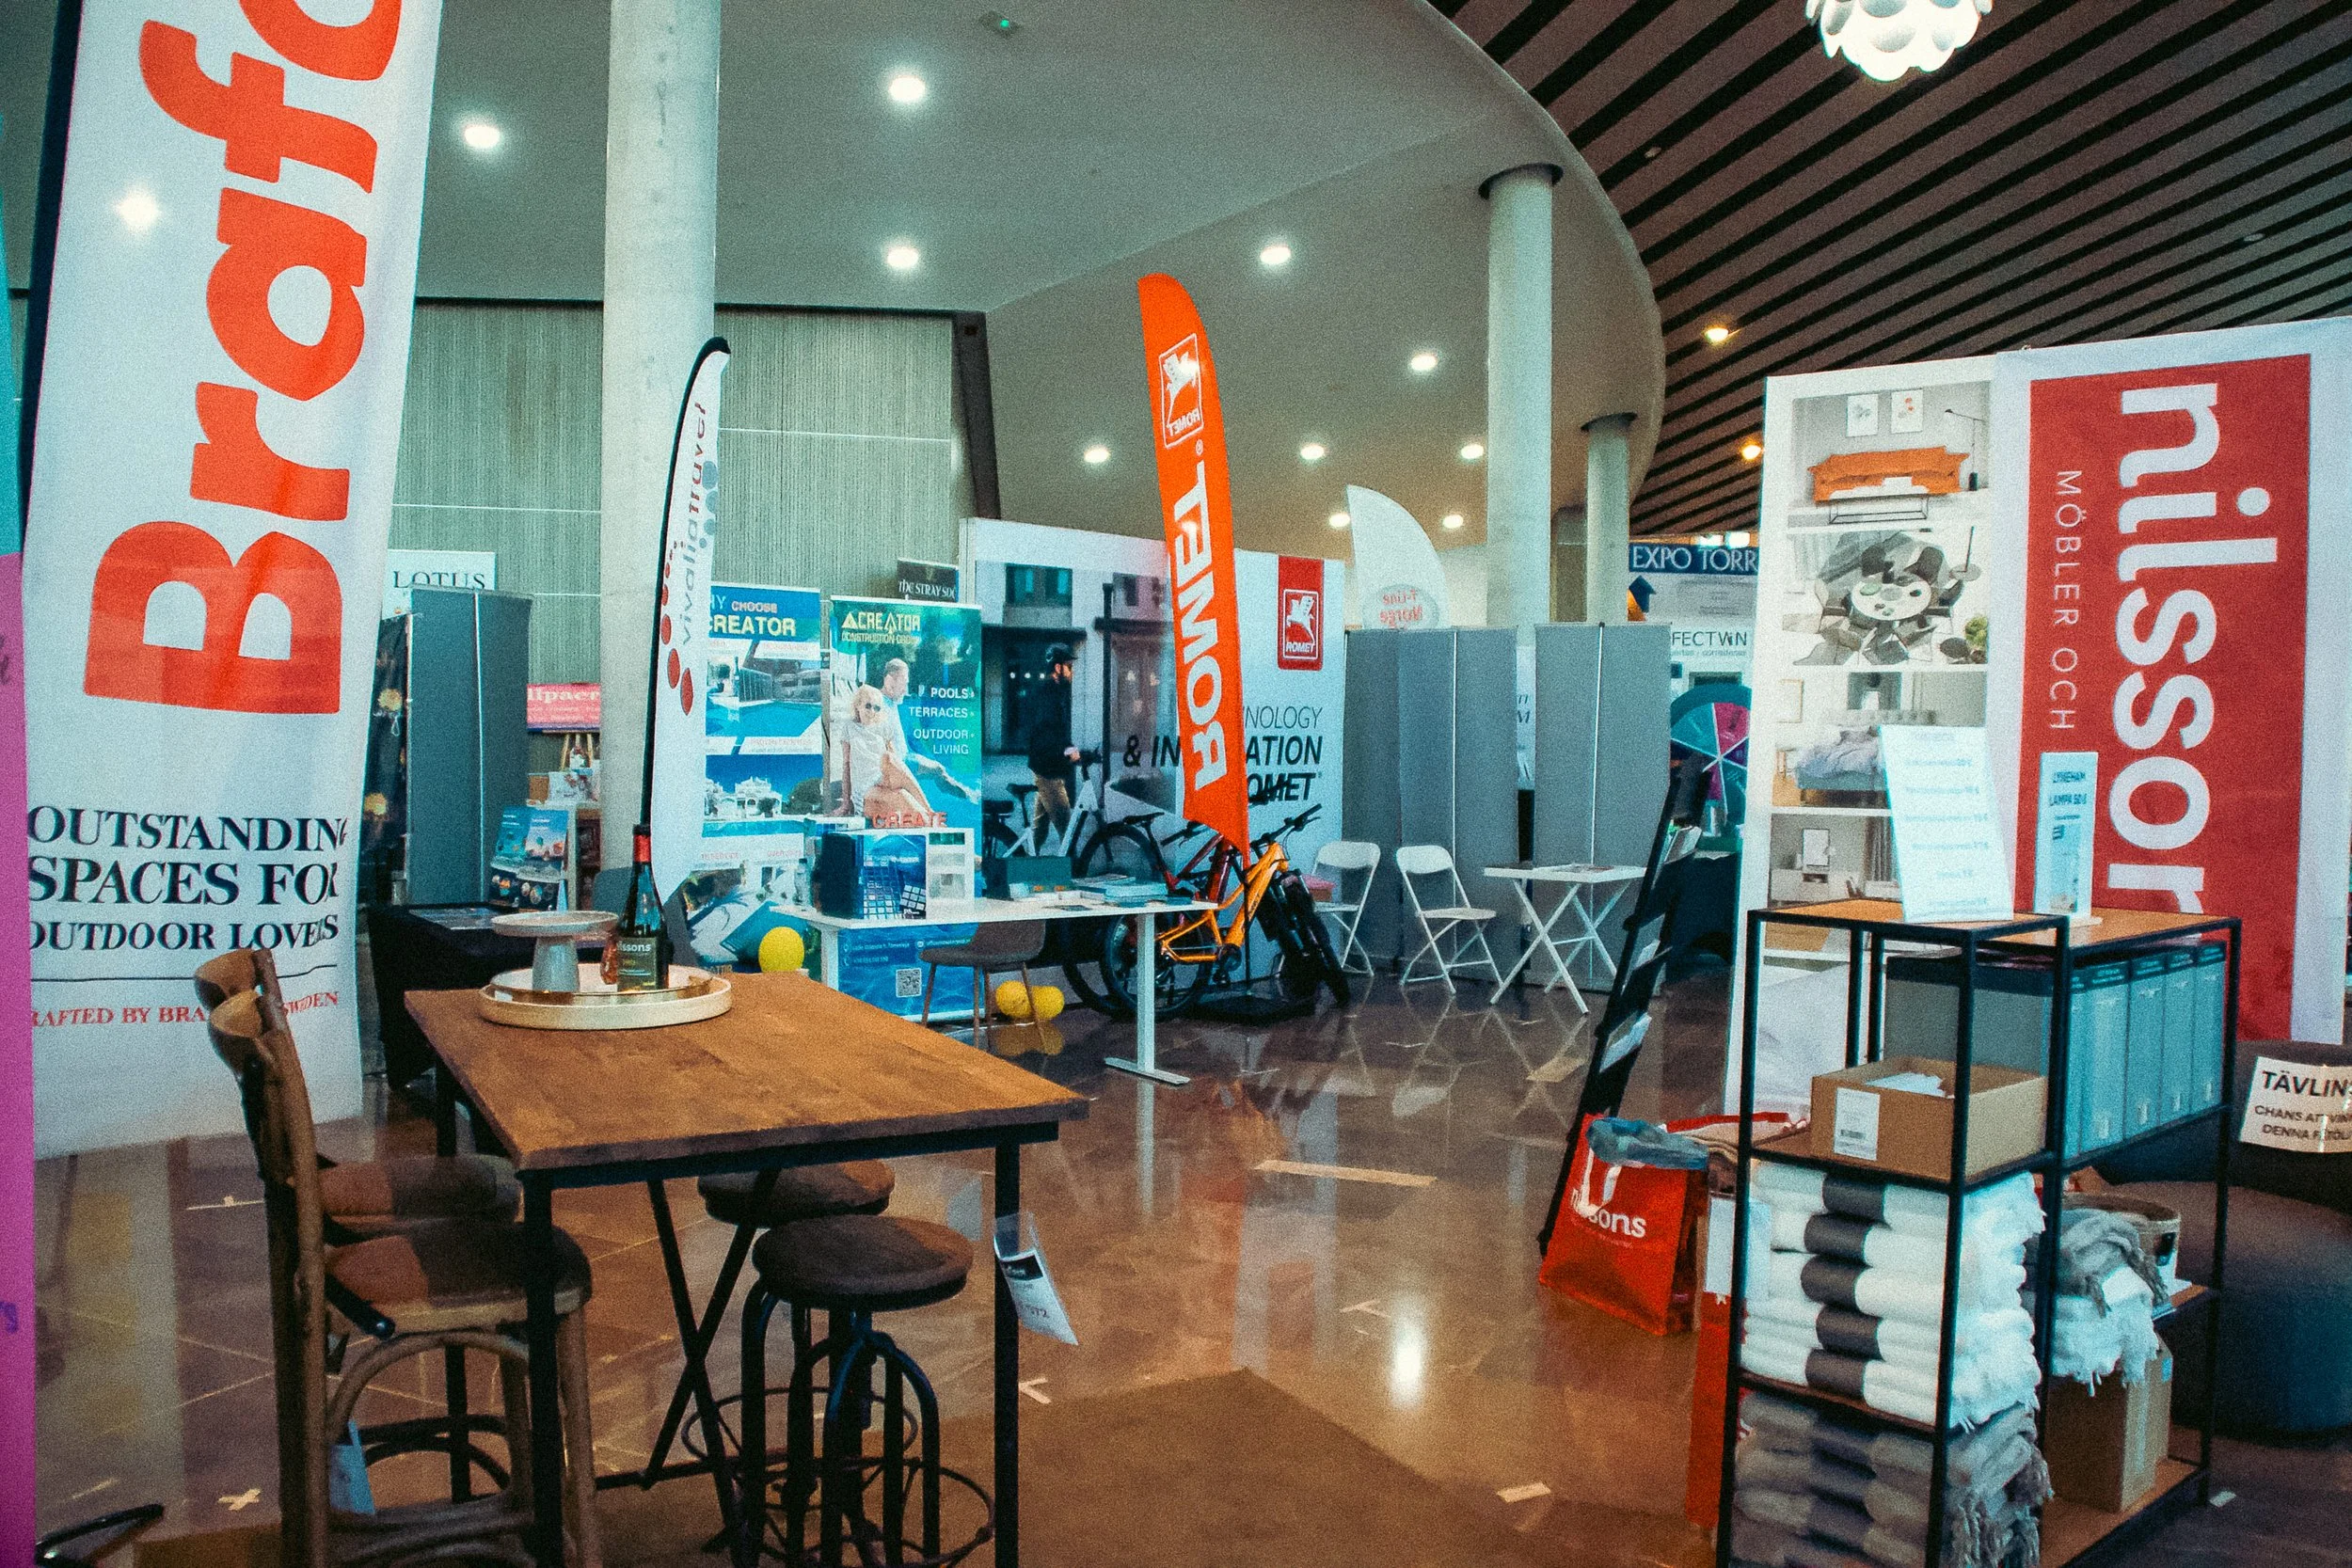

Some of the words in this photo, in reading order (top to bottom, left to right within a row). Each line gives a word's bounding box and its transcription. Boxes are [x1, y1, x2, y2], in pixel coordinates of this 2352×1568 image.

[2052, 470, 2087, 626] MÖBLER
[1632, 546, 1692, 569] EXPO
[393, 571, 485, 590] LOTUS
[731, 601, 778, 614] CHOOSE
[1285, 641, 1315, 653] ROMET
[930, 687, 968, 699] POOLS
[2049, 647, 2077, 730] OCH
[909, 706, 968, 718] TERRACES
[1243, 705, 1323, 729] NOLOGY
[914, 729, 968, 740] OUTDOOR
[933, 743, 969, 754] LIVING
[1122, 735, 1141, 768] &
[1247, 772, 1316, 802] OMET
[28, 855, 239, 905] SPACES
[122, 1007, 151, 1024] BY
[2261, 1069, 2352, 1098] TÄVLIN
[2254, 1104, 2302, 1121] CHANS
[2262, 1124, 2309, 1138] DENNA
